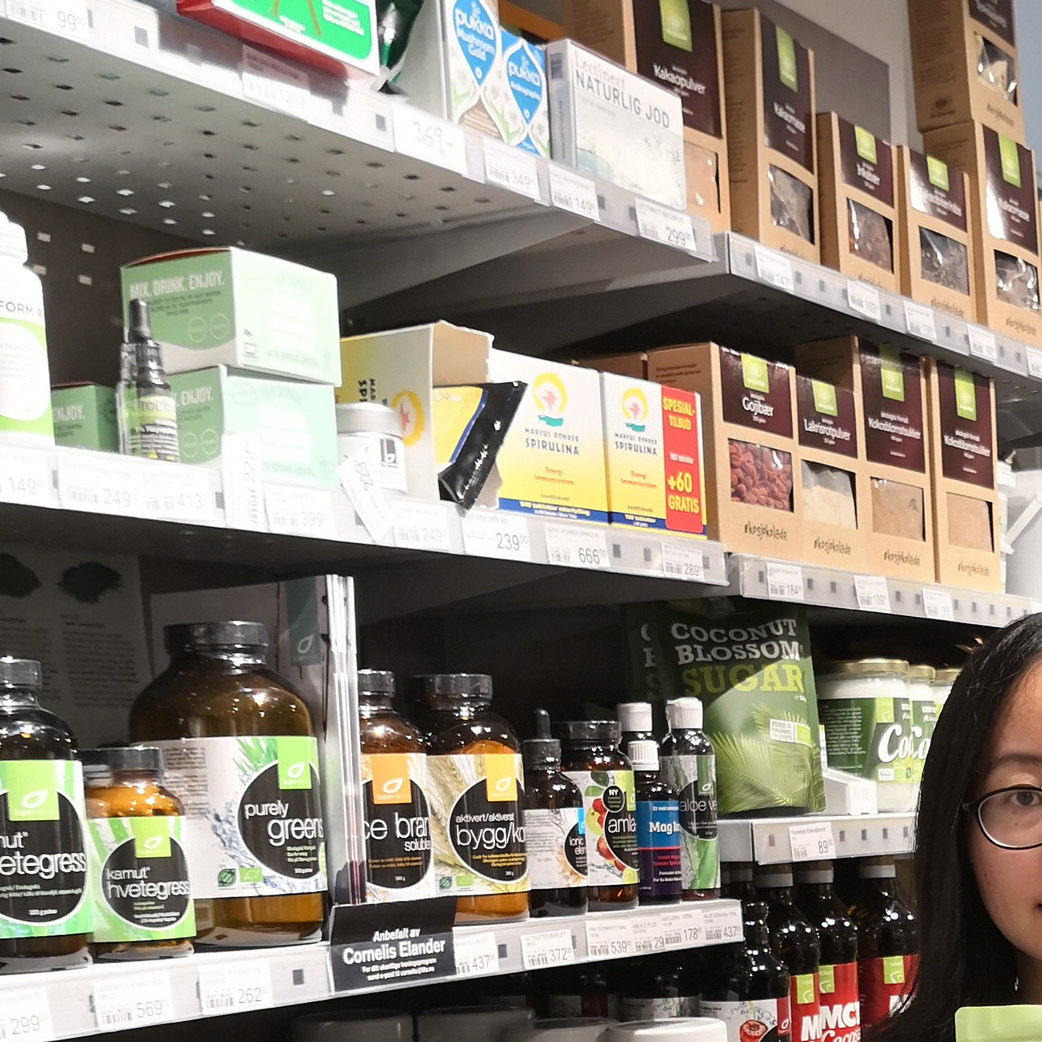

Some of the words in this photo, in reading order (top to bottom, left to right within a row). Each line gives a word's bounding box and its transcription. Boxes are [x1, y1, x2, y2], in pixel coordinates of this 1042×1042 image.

[454, 8, 494, 41] pukka
[507, 60, 541, 87] pukka
[576, 70, 641, 115] NATURLIG
[646, 106, 670, 129] JOD
[525, 437, 579, 455] SPIRULINA
[615, 440, 658, 456] SPIRULINA
[668, 471, 692, 493] +60
[668, 494, 699, 514] GRATIS
[671, 618, 797, 643] COCONUT
[675, 640, 800, 666] BLOSSOM
[681, 664, 805, 696] SUGAR
[244, 800, 289, 820] purely
[679, 799, 707, 812] aloe
[108, 881, 191, 900] hvetegress
[373, 927, 409, 942] Anbefalt
[410, 928, 421, 938] av
[343, 943, 397, 965] Cornelis
[399, 938, 446, 958] Elander
